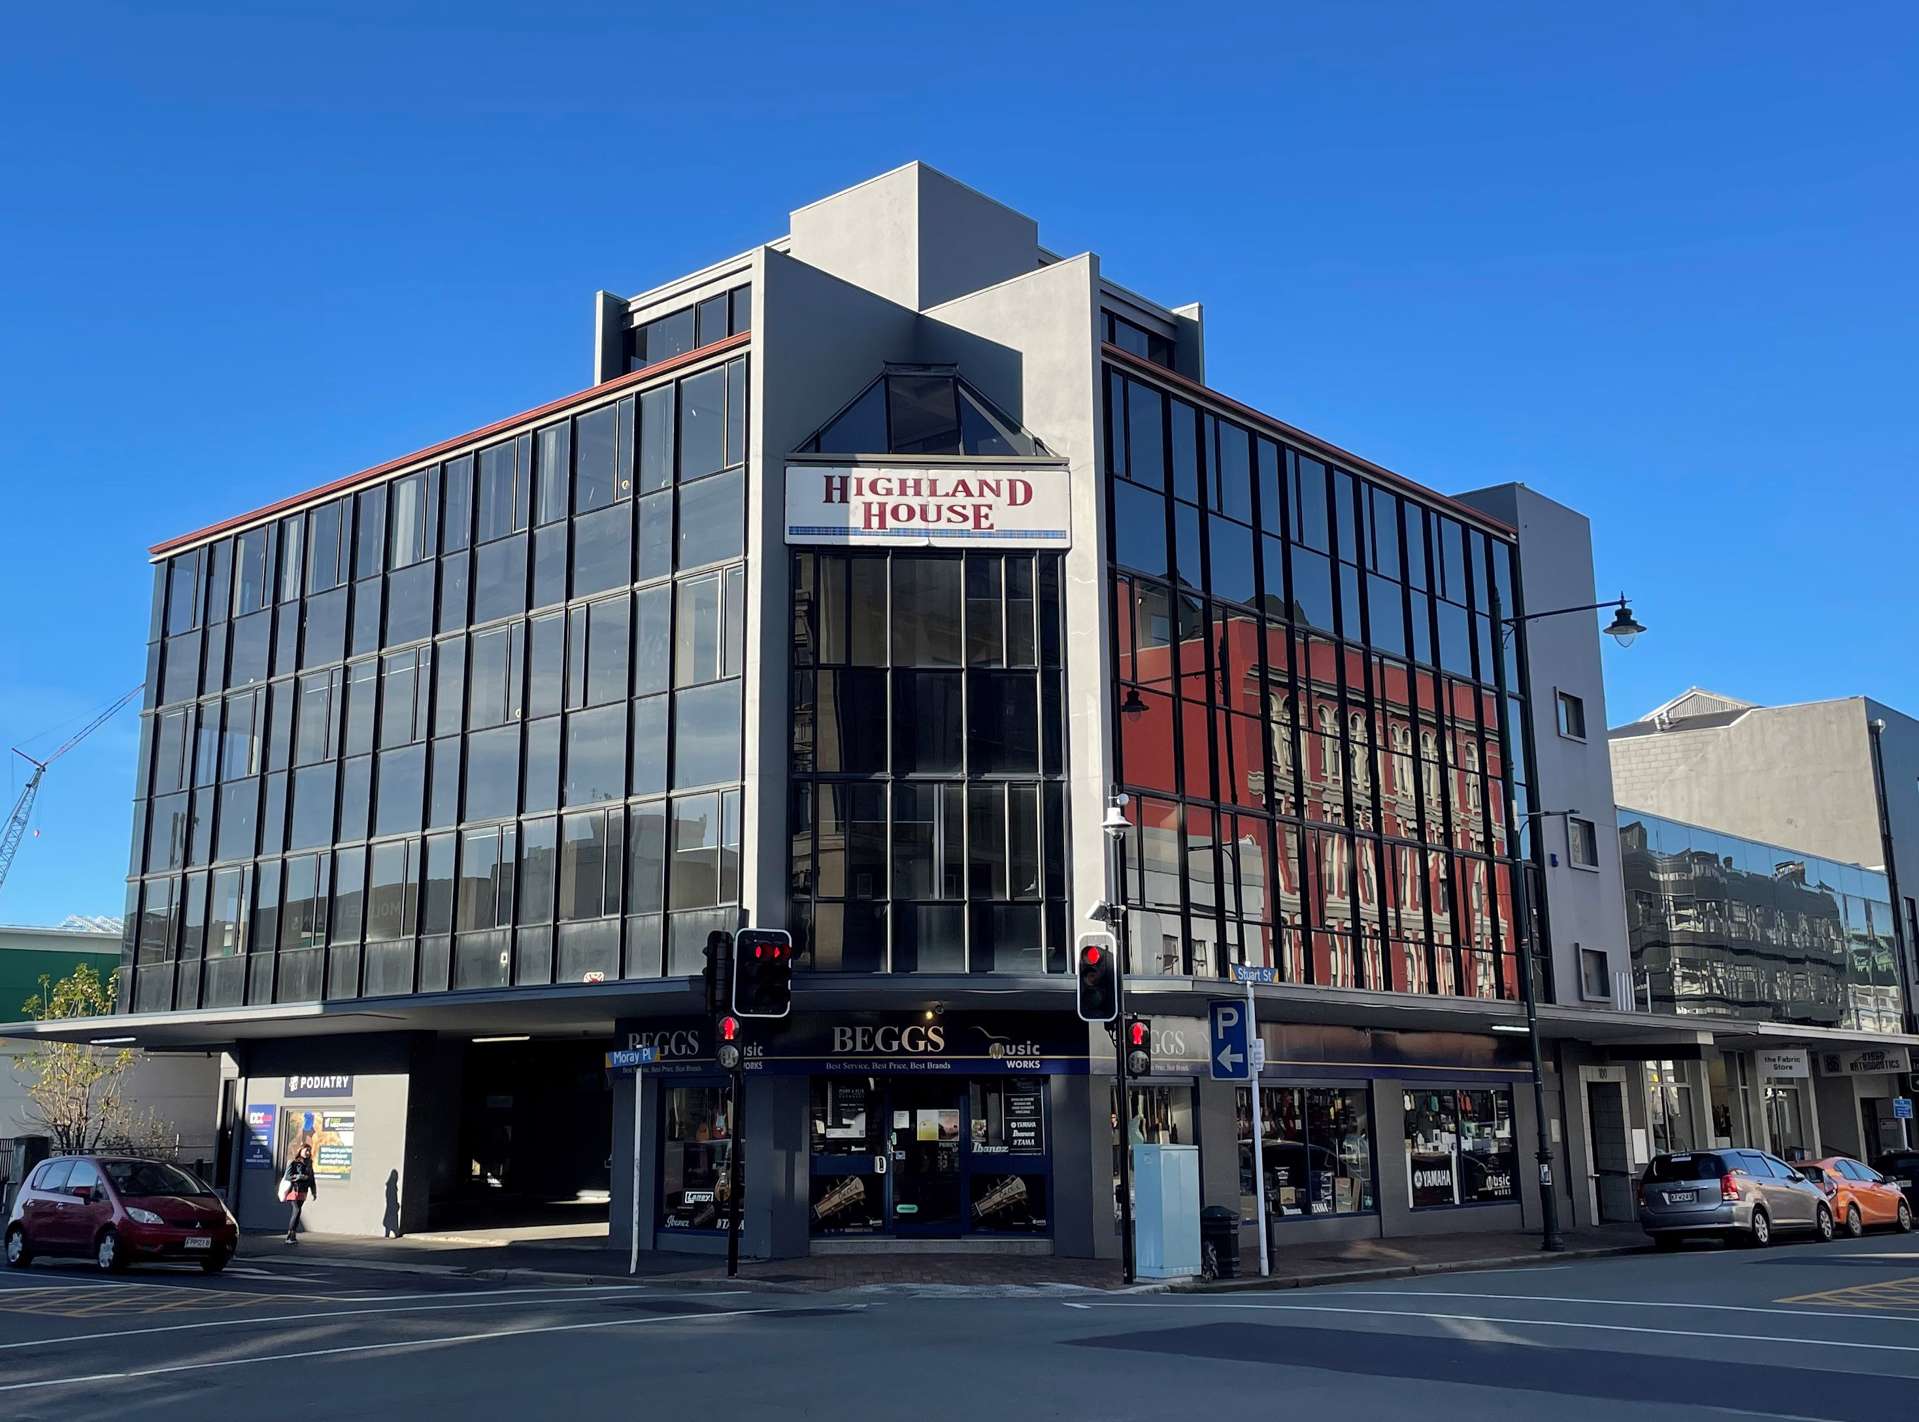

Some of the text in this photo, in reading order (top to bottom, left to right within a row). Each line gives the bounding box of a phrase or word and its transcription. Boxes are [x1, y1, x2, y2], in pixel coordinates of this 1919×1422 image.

[822, 475, 1033, 507] HIGHLAND
[861, 501, 995, 531] HOUSE
[1238, 967, 1272, 982] Stuart St
[1217, 1007, 1239, 1040] P
[832, 1026, 945, 1052] BEGGS
[1150, 1030, 1185, 1056] GGS
[613, 1047, 651, 1065] Moray Pl
[1764, 1055, 1801, 1063] the Fabric
[743, 1061, 763, 1070] ORKS
[826, 1062, 841, 1070] Best
[872, 1062, 887, 1070] Best
[910, 1062, 925, 1070] Best
[927, 1061, 951, 1070] Brands
[1006, 1060, 1041, 1069] WORKS
[1773, 1063, 1793, 1071] Store
[300, 1076, 349, 1089] PODIATRY
[972, 1142, 1009, 1153] Ibanez
[1422, 1169, 1451, 1187] YAMAHA
